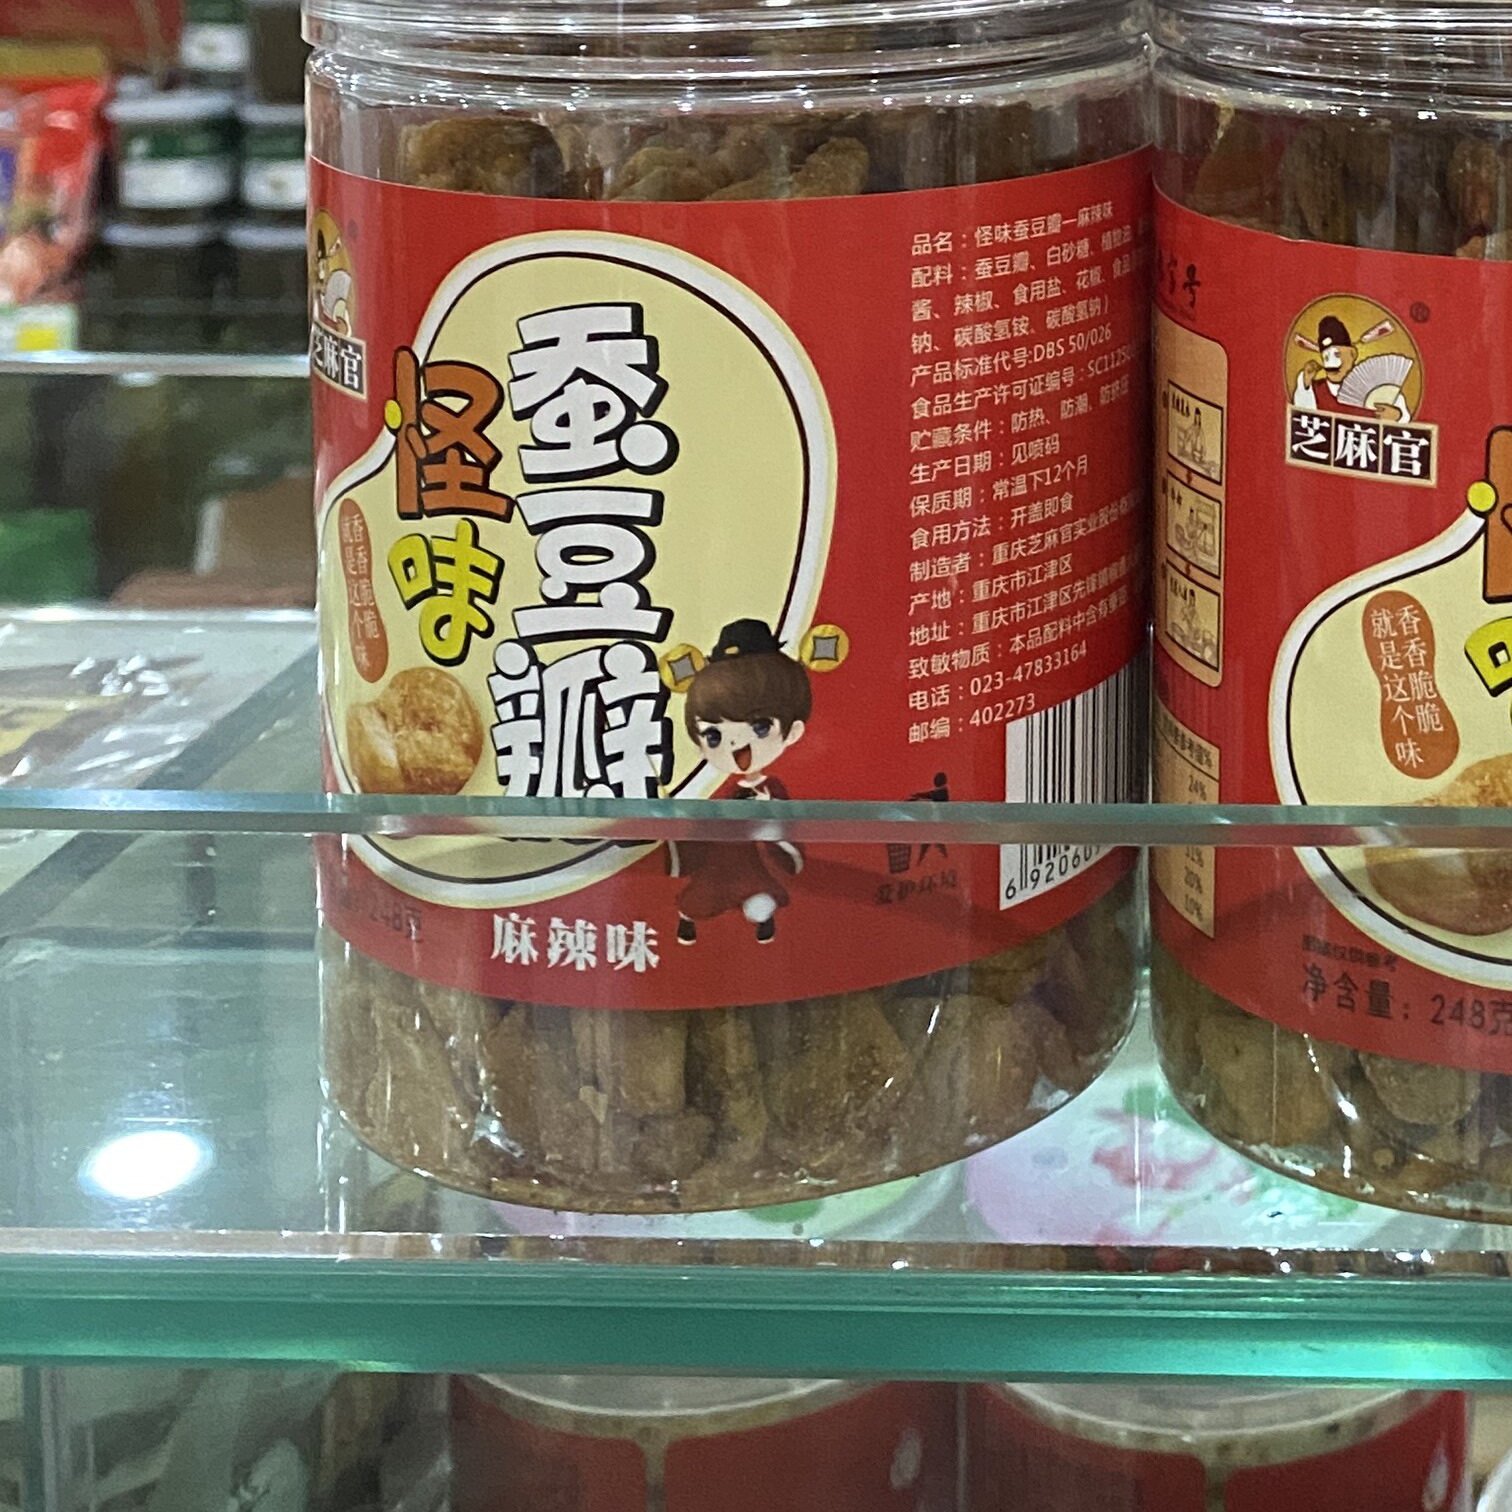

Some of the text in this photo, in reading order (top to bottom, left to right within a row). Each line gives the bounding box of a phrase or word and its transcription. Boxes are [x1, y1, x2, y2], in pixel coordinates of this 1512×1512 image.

[1292, 415, 1429, 475] 芝麻官
[1371, 608, 1423, 768] 就是这个味
[1397, 605, 1444, 733] 香香脆脆
[491, 912, 660, 972] 麻辣味
